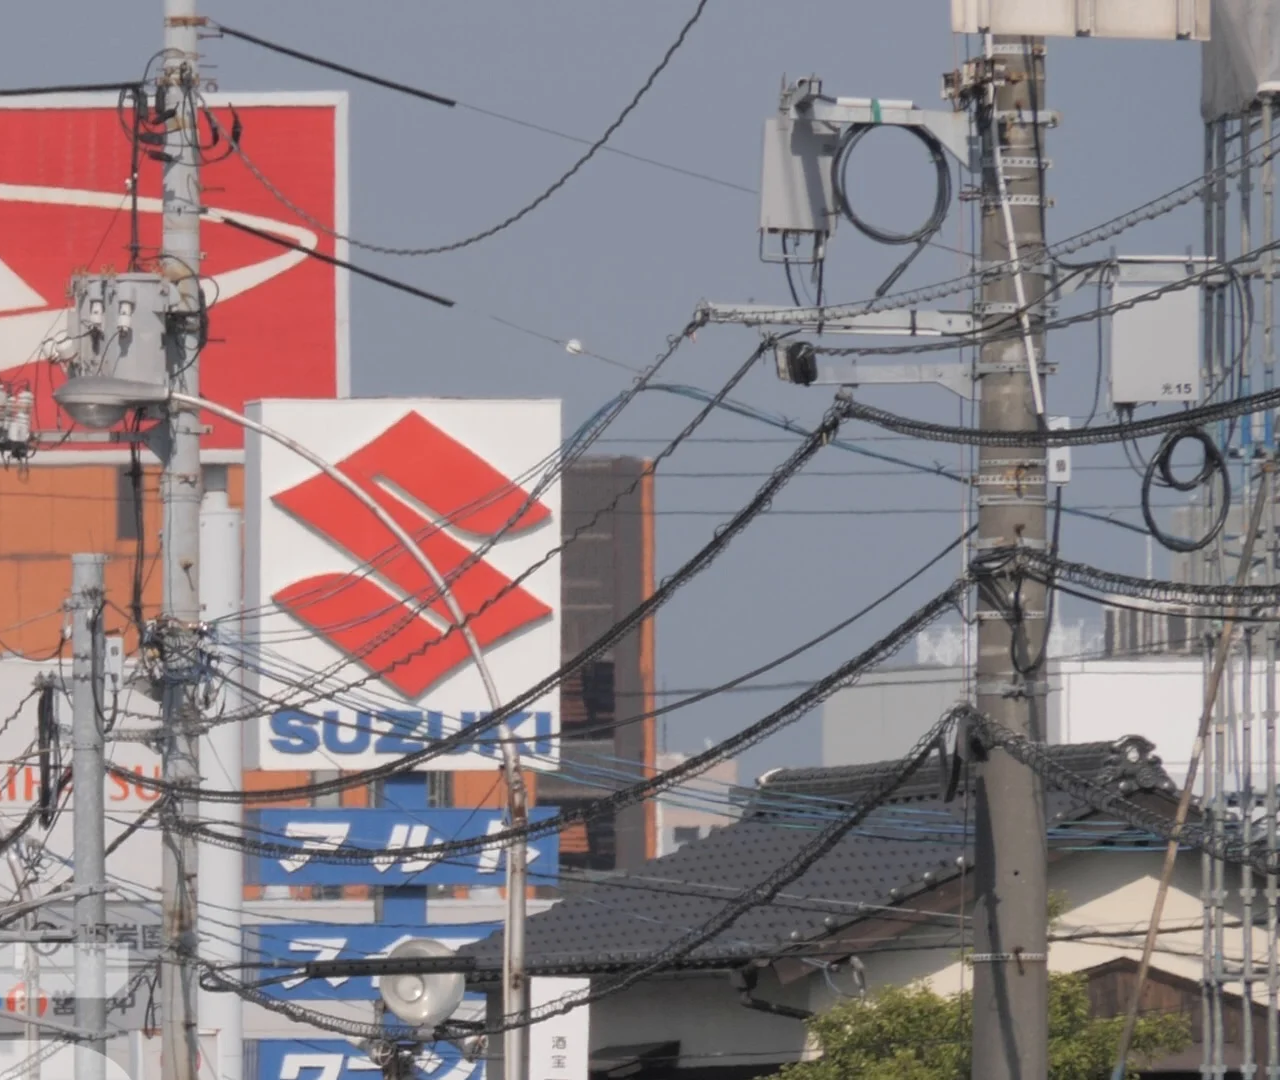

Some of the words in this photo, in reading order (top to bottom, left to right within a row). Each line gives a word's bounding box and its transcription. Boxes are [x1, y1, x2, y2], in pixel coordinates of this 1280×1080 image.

[269, 708, 552, 755] SUZUKI
[281, 821, 538, 873] アルト
